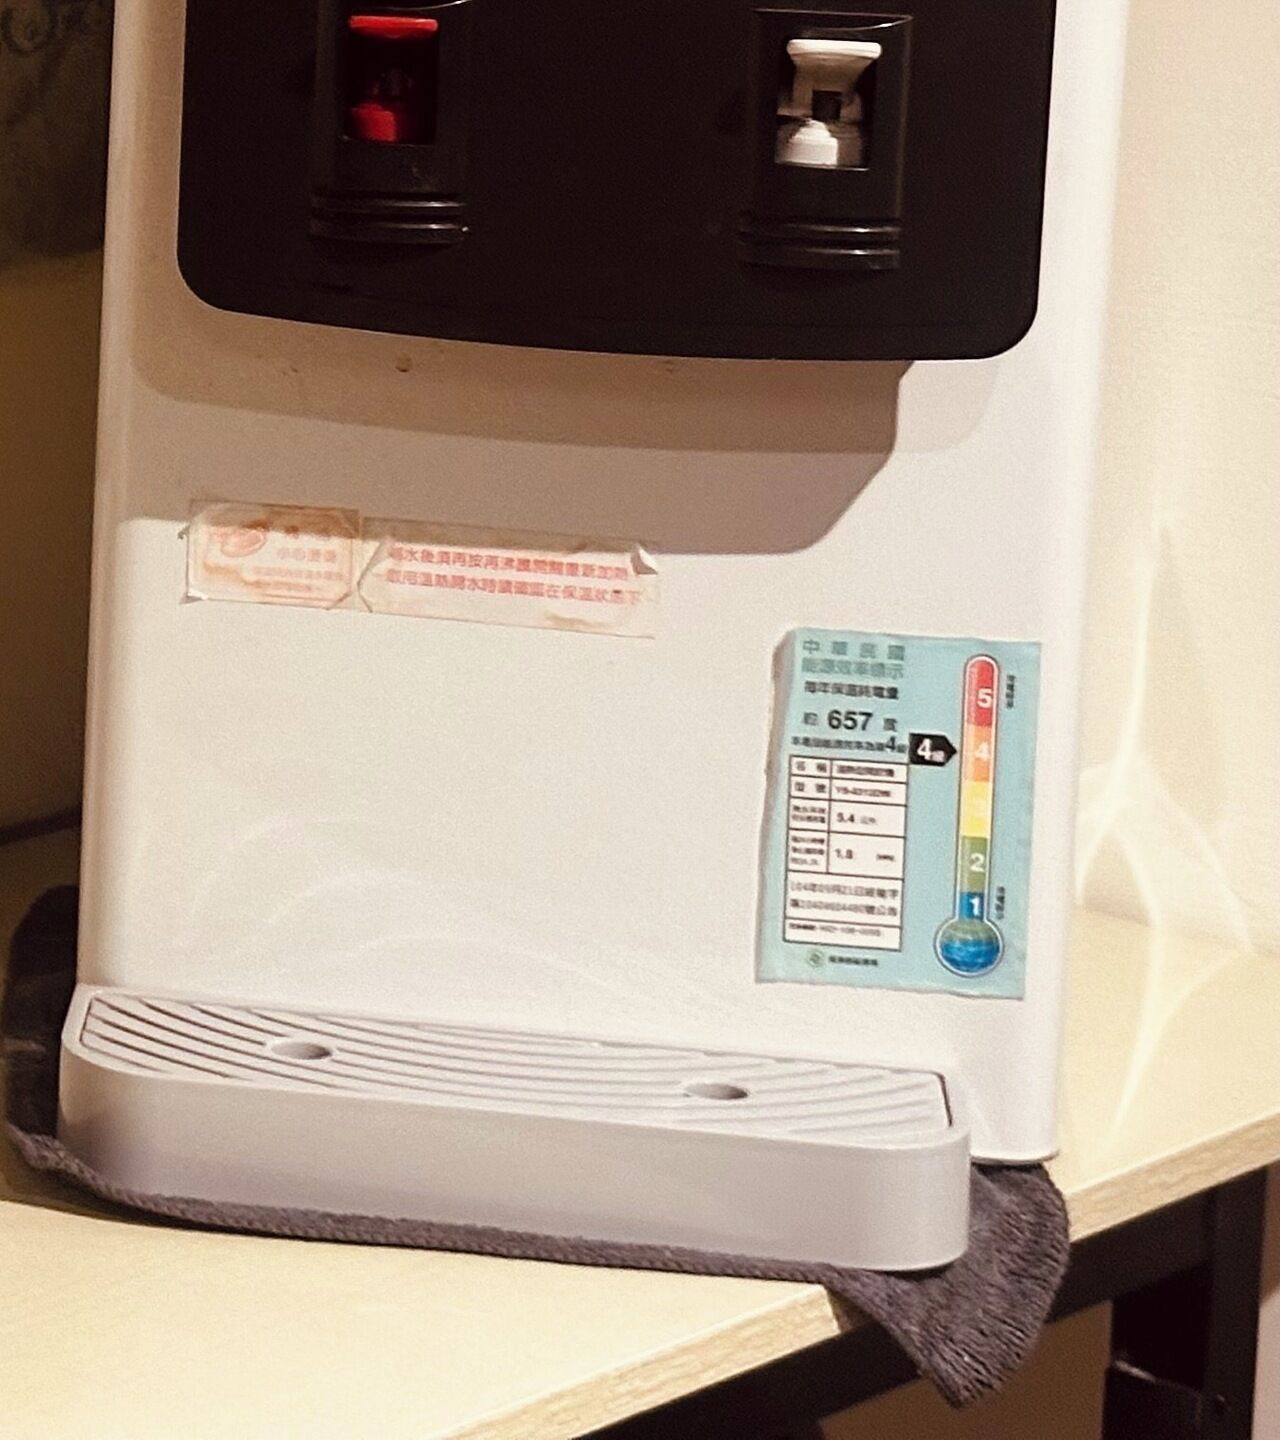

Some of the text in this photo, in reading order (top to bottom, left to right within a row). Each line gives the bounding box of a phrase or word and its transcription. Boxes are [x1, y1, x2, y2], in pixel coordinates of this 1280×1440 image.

[977, 688, 993, 708] 5
[828, 710, 873, 731] 657
[970, 853, 985, 873] 2
[969, 896, 981, 917] 1
